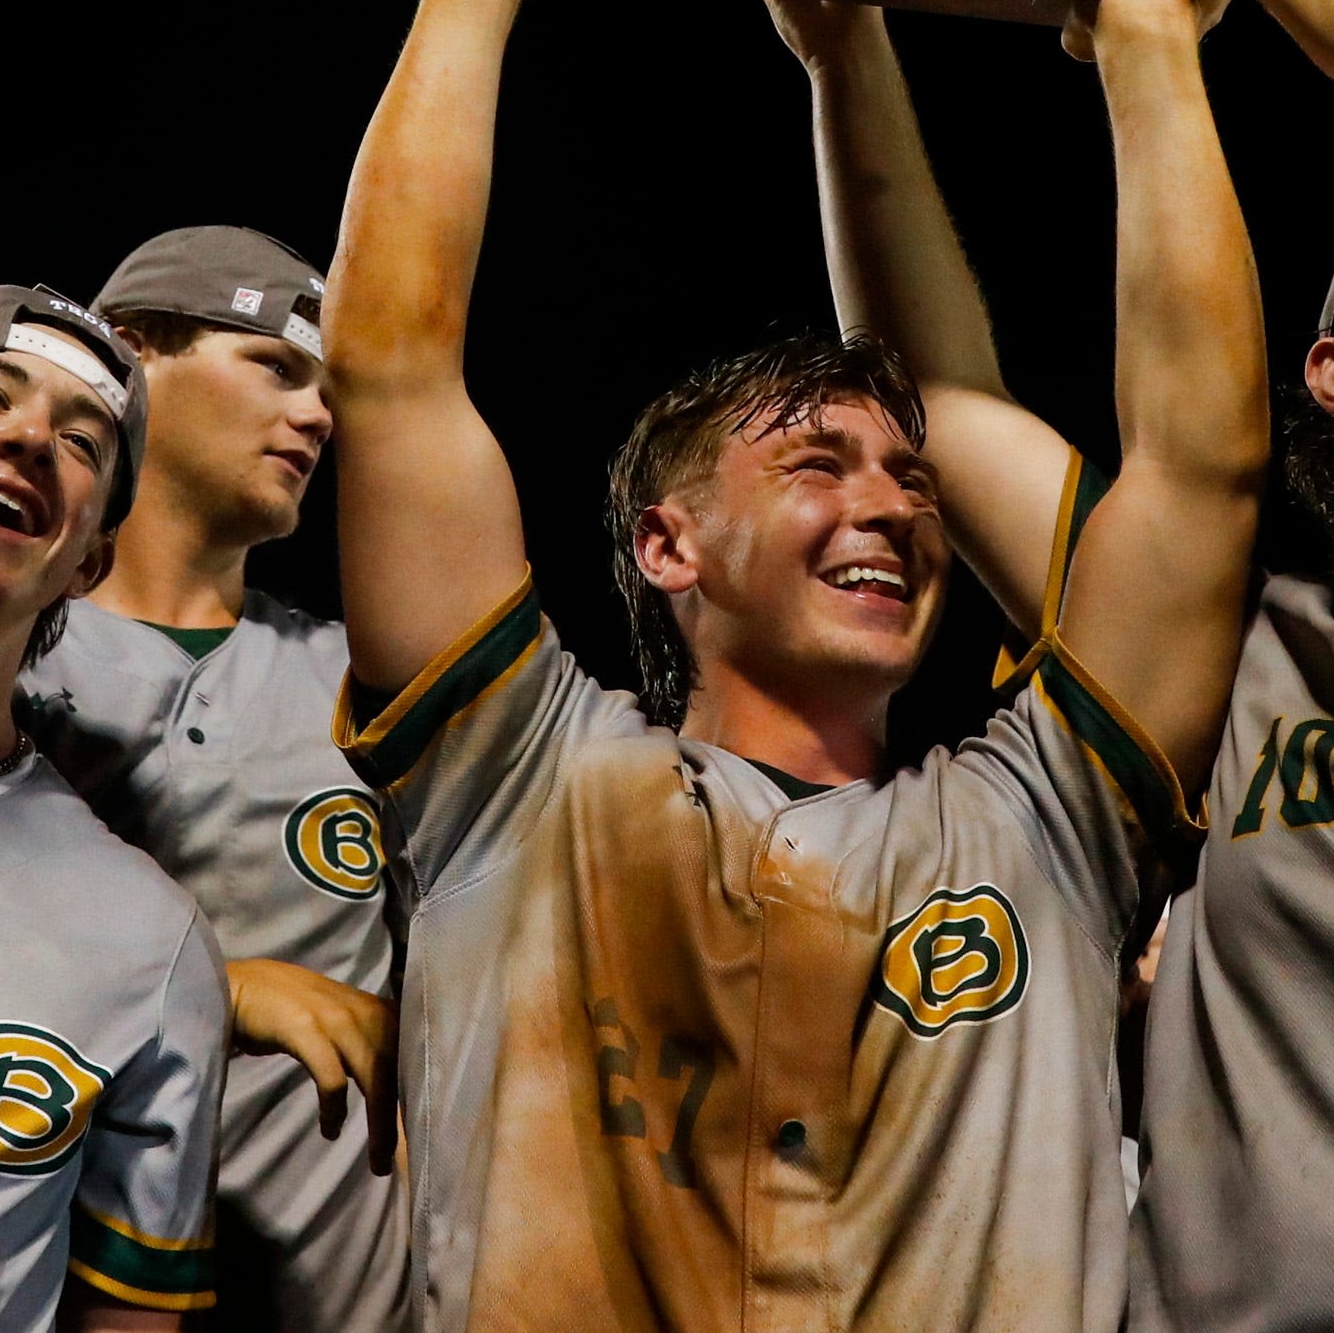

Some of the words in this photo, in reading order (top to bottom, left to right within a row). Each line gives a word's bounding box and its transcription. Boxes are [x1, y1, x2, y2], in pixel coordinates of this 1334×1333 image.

[318, 810, 381, 878] B
[911, 916, 1001, 1009] B
[592, 994, 719, 1192] 27
